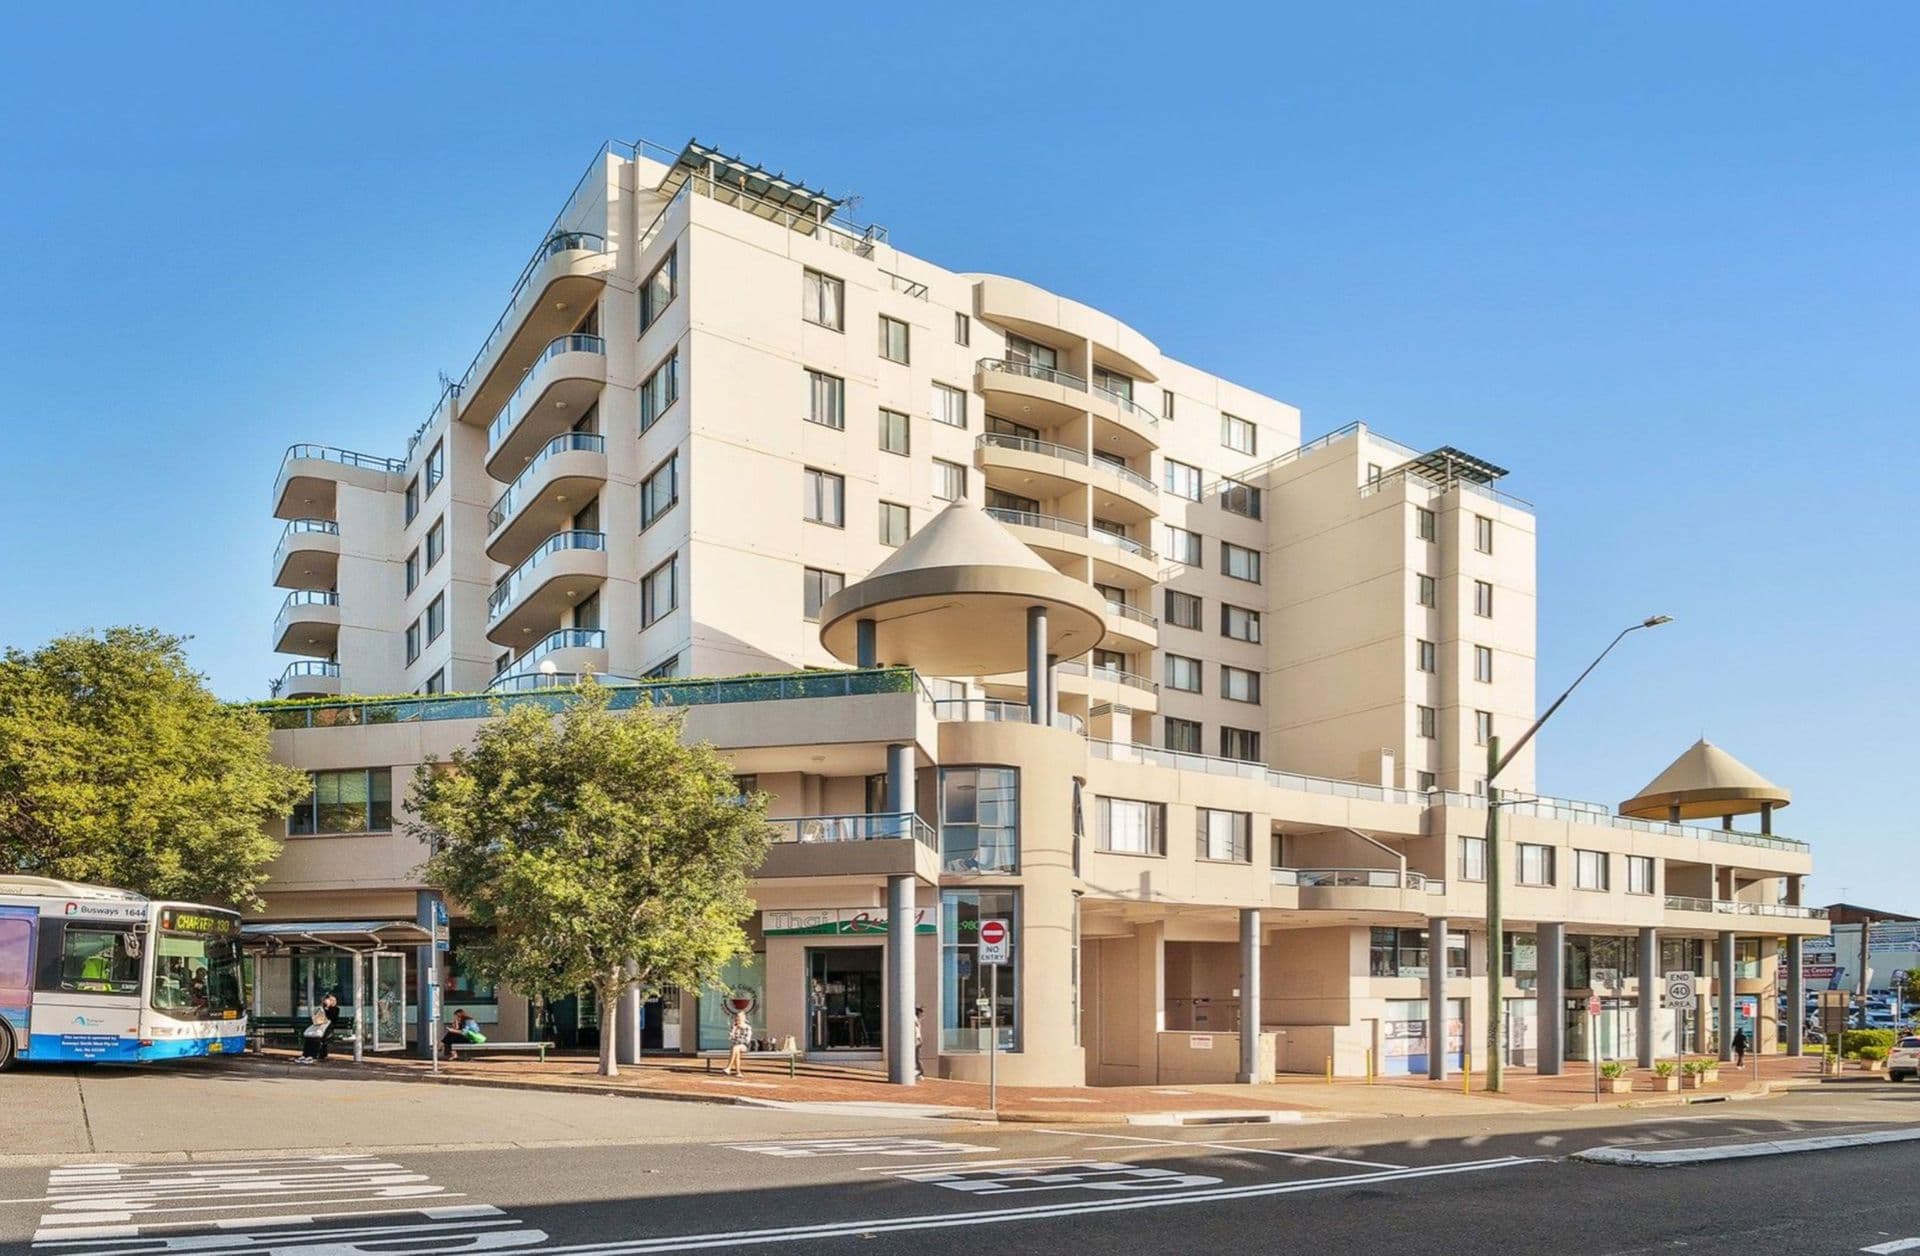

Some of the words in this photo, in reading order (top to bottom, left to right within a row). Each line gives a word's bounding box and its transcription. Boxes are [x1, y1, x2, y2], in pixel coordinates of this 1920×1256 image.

[80, 905, 119, 916] Busways
[124, 908, 146, 917] 1644
[769, 910, 828, 930] Thai
[850, 908, 925, 932] Cuy
[985, 945, 1000, 953] NO
[1670, 973, 1690, 982] END
[1672, 986, 1688, 996] 40
